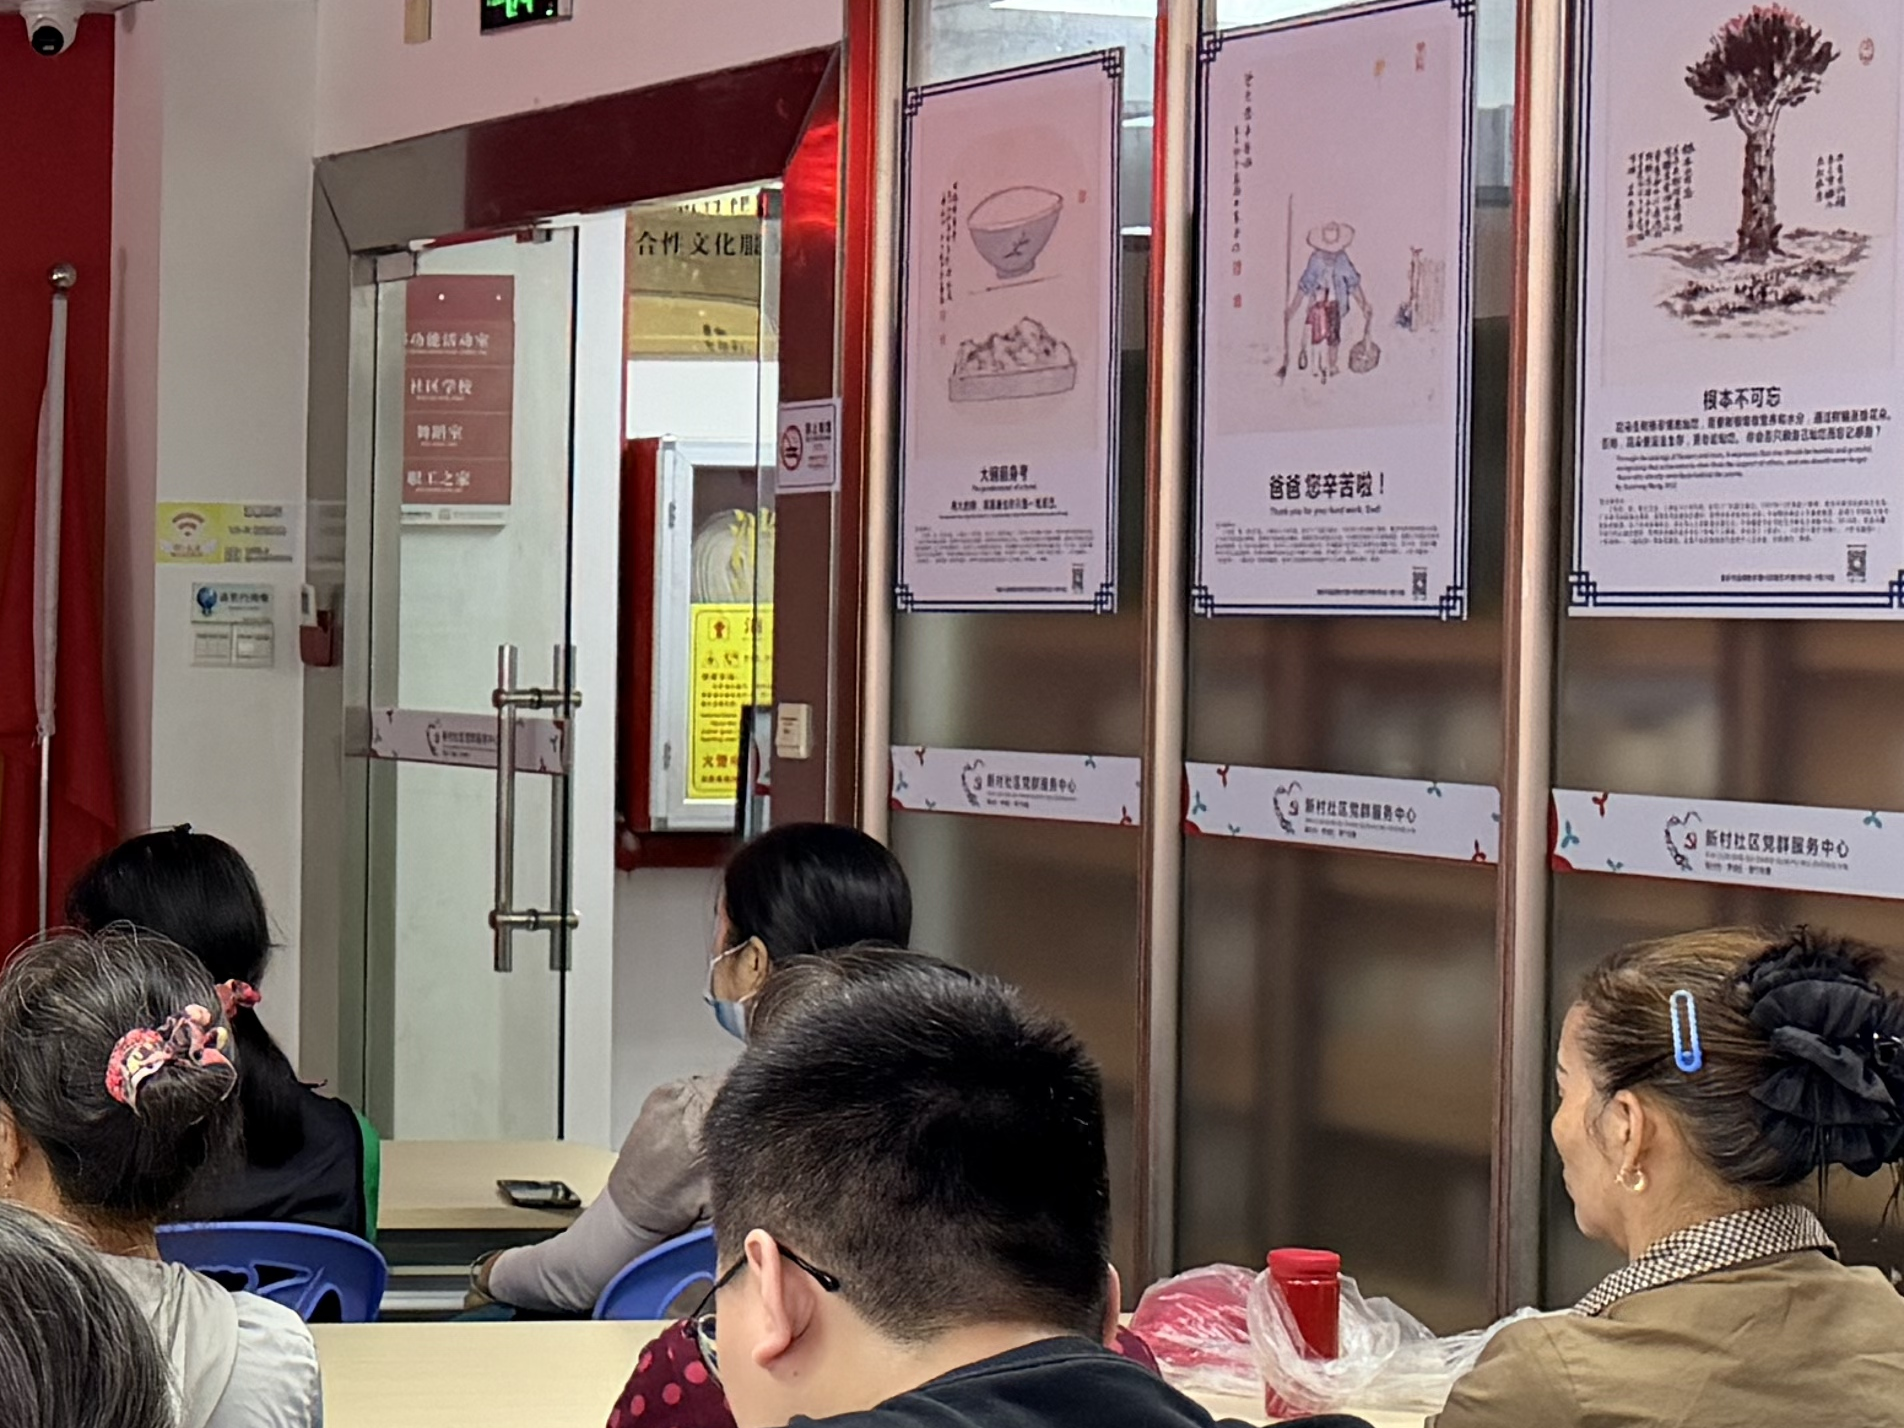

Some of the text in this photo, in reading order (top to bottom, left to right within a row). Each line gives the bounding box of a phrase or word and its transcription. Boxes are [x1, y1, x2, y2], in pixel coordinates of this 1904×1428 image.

[404, 331, 490, 349] 功能活动室
[1703, 385, 1781, 411] 根本不可忘
[1305, 797, 1417, 823] 新村社区党群服务中心
[1705, 829, 1850, 859] 新村社区党群服务中心
